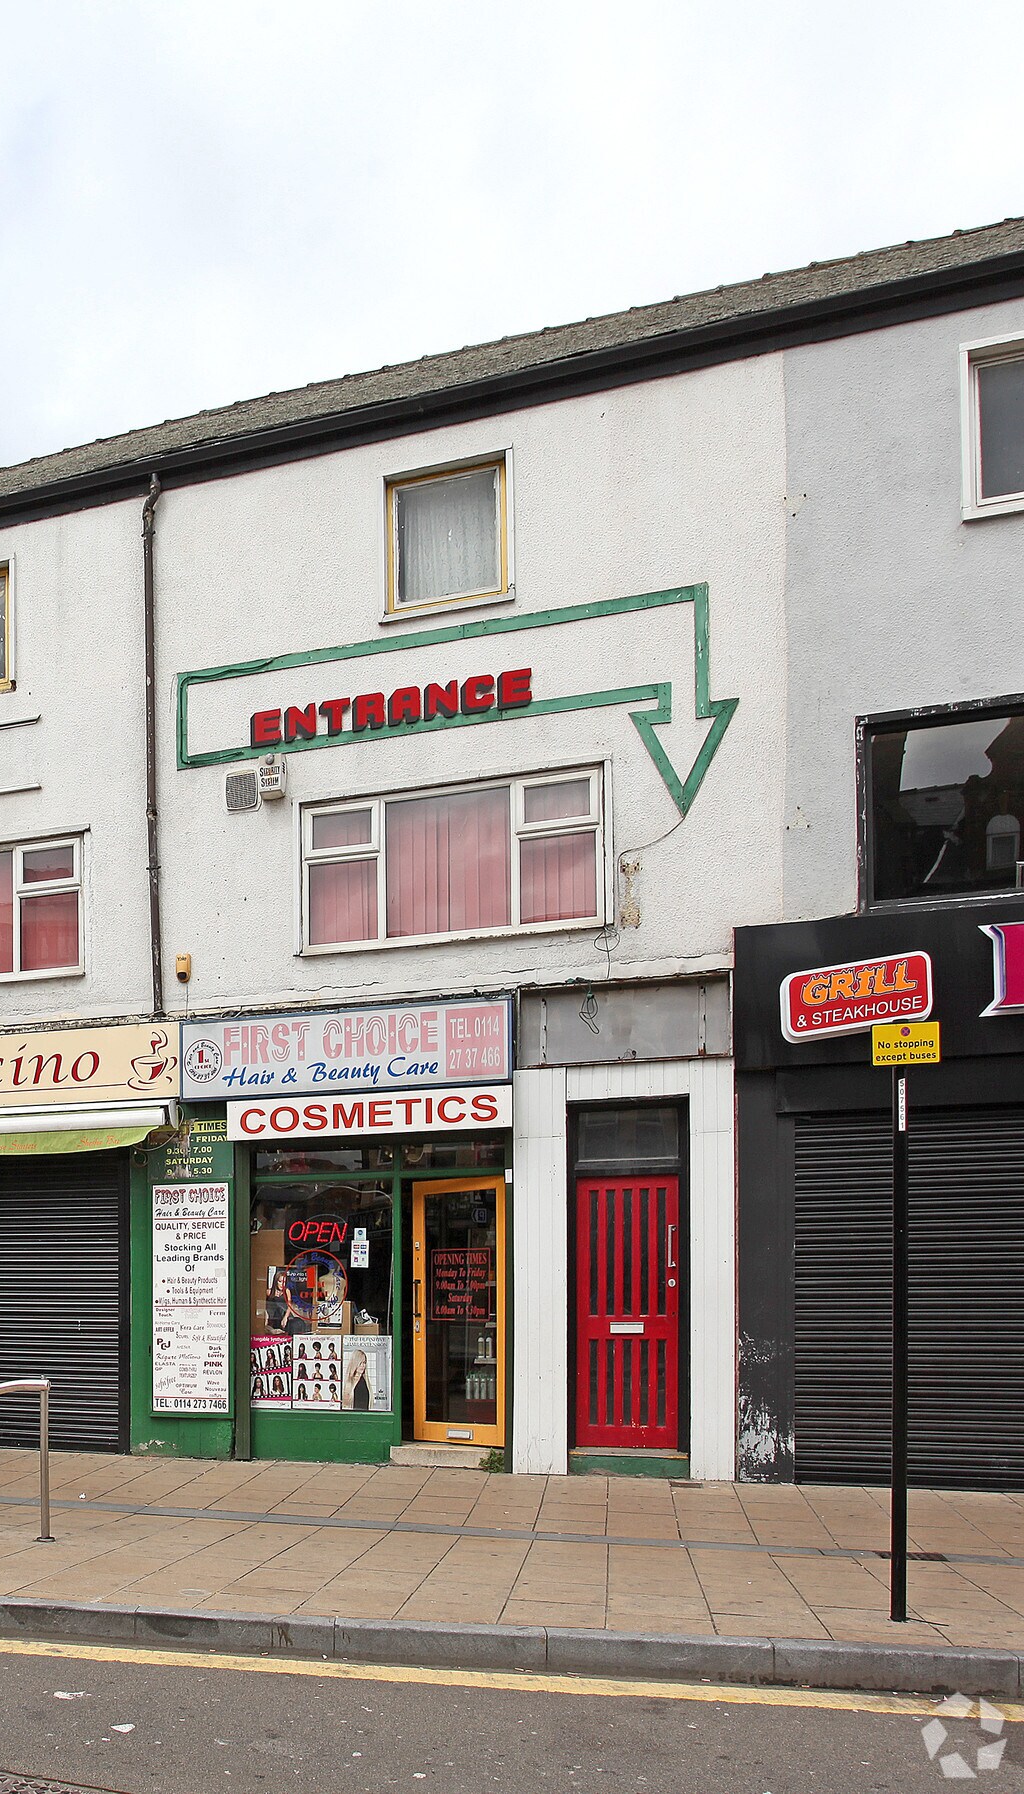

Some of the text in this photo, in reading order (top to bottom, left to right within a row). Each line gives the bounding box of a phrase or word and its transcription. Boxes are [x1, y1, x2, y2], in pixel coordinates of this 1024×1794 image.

[250, 667, 533, 748] ENTRANCE
[801, 961, 918, 1006] GRILL
[796, 995, 923, 1028] & STEAKHOUSE
[449, 1015, 501, 1039] TEL 0114
[222, 1010, 439, 1067] FIRST CHOICE
[878, 1039, 934, 1051] No stopping
[449, 1045, 501, 1070] 27 37 466
[875, 1051, 937, 1062] except buses
[221, 1056, 439, 1088] Hair & Beauty Care
[239, 1093, 499, 1135] COSMETICS
[197, 1121, 227, 1131] TIMES
[196, 1135, 228, 1143] FRIDAY
[193, 1146, 212, 1154] 7.00
[165, 1156, 213, 1166] SATURDAY
[193, 1167, 213, 1175] 5.30
[154, 1186, 226, 1206] FIRST CHOICE
[154, 1207, 173, 1218] Hair
[181, 1207, 206, 1218] Beauty
[207, 1206, 225, 1217] Care
[154, 1221, 226, 1231] QUALITY, SERVICE
[288, 1221, 349, 1243] OPEN
[183, 1231, 207, 1240] PRICE
[164, 1243, 217, 1253] Stocking All
[156, 1253, 225, 1264] Leading Brands
[434, 1252, 488, 1265] OPENING TIMES
[184, 1264, 195, 1272] Of
[436, 1267, 487, 1279] Monday To Friday
[167, 1276, 176, 1284] Hair
[457, 1280, 464, 1289] To
[448, 1292, 474, 1304] Saturday
[457, 1305, 464, 1314] To
[154, 1398, 227, 1410] TEL: 0114 273 7466
